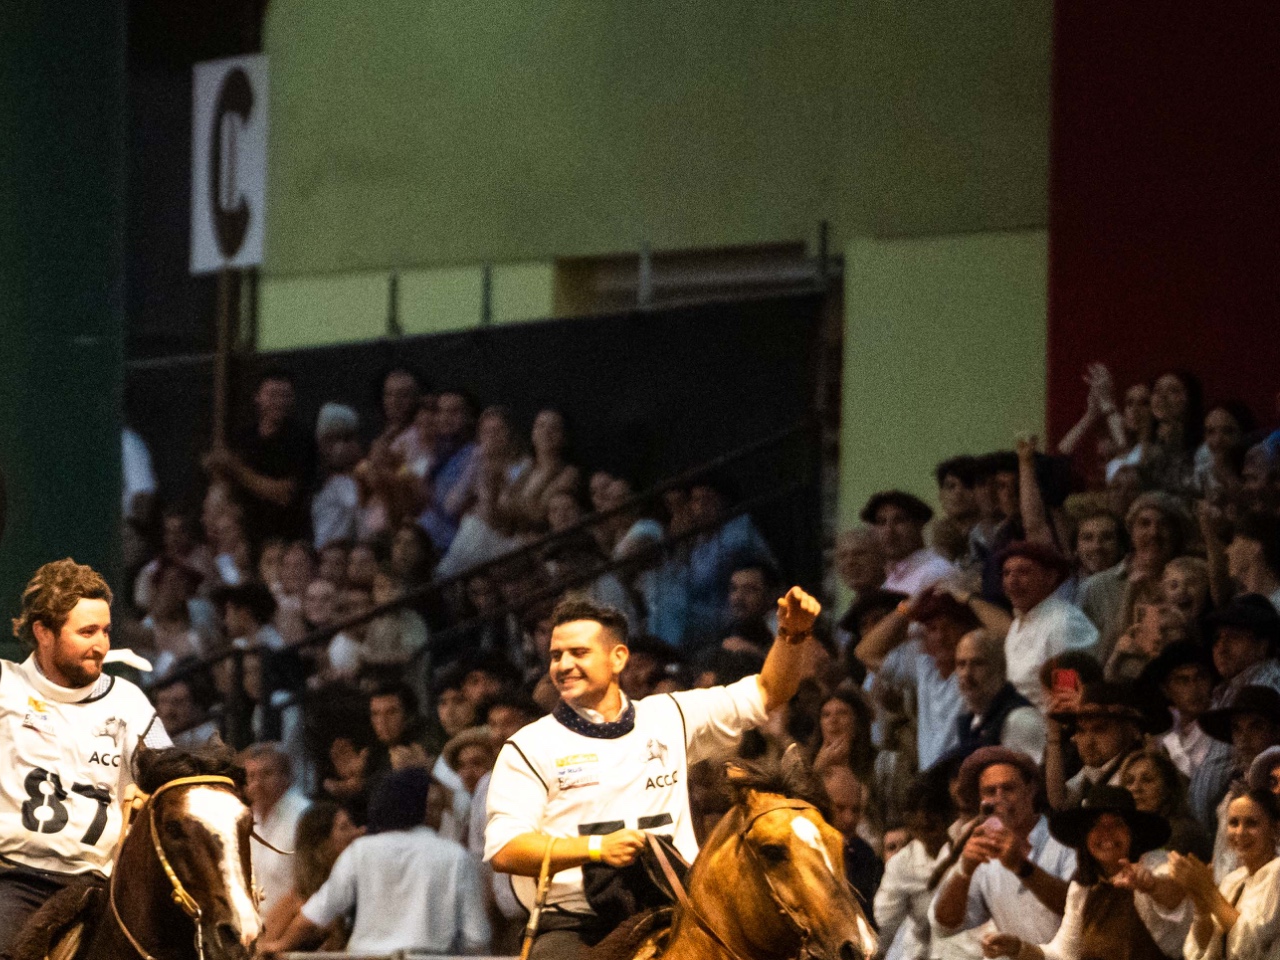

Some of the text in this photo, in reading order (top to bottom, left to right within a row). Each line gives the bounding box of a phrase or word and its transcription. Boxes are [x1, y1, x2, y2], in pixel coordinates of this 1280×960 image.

[209, 66, 254, 259] C
[21, 766, 112, 846] 87
[645, 770, 678, 791] ACCC
